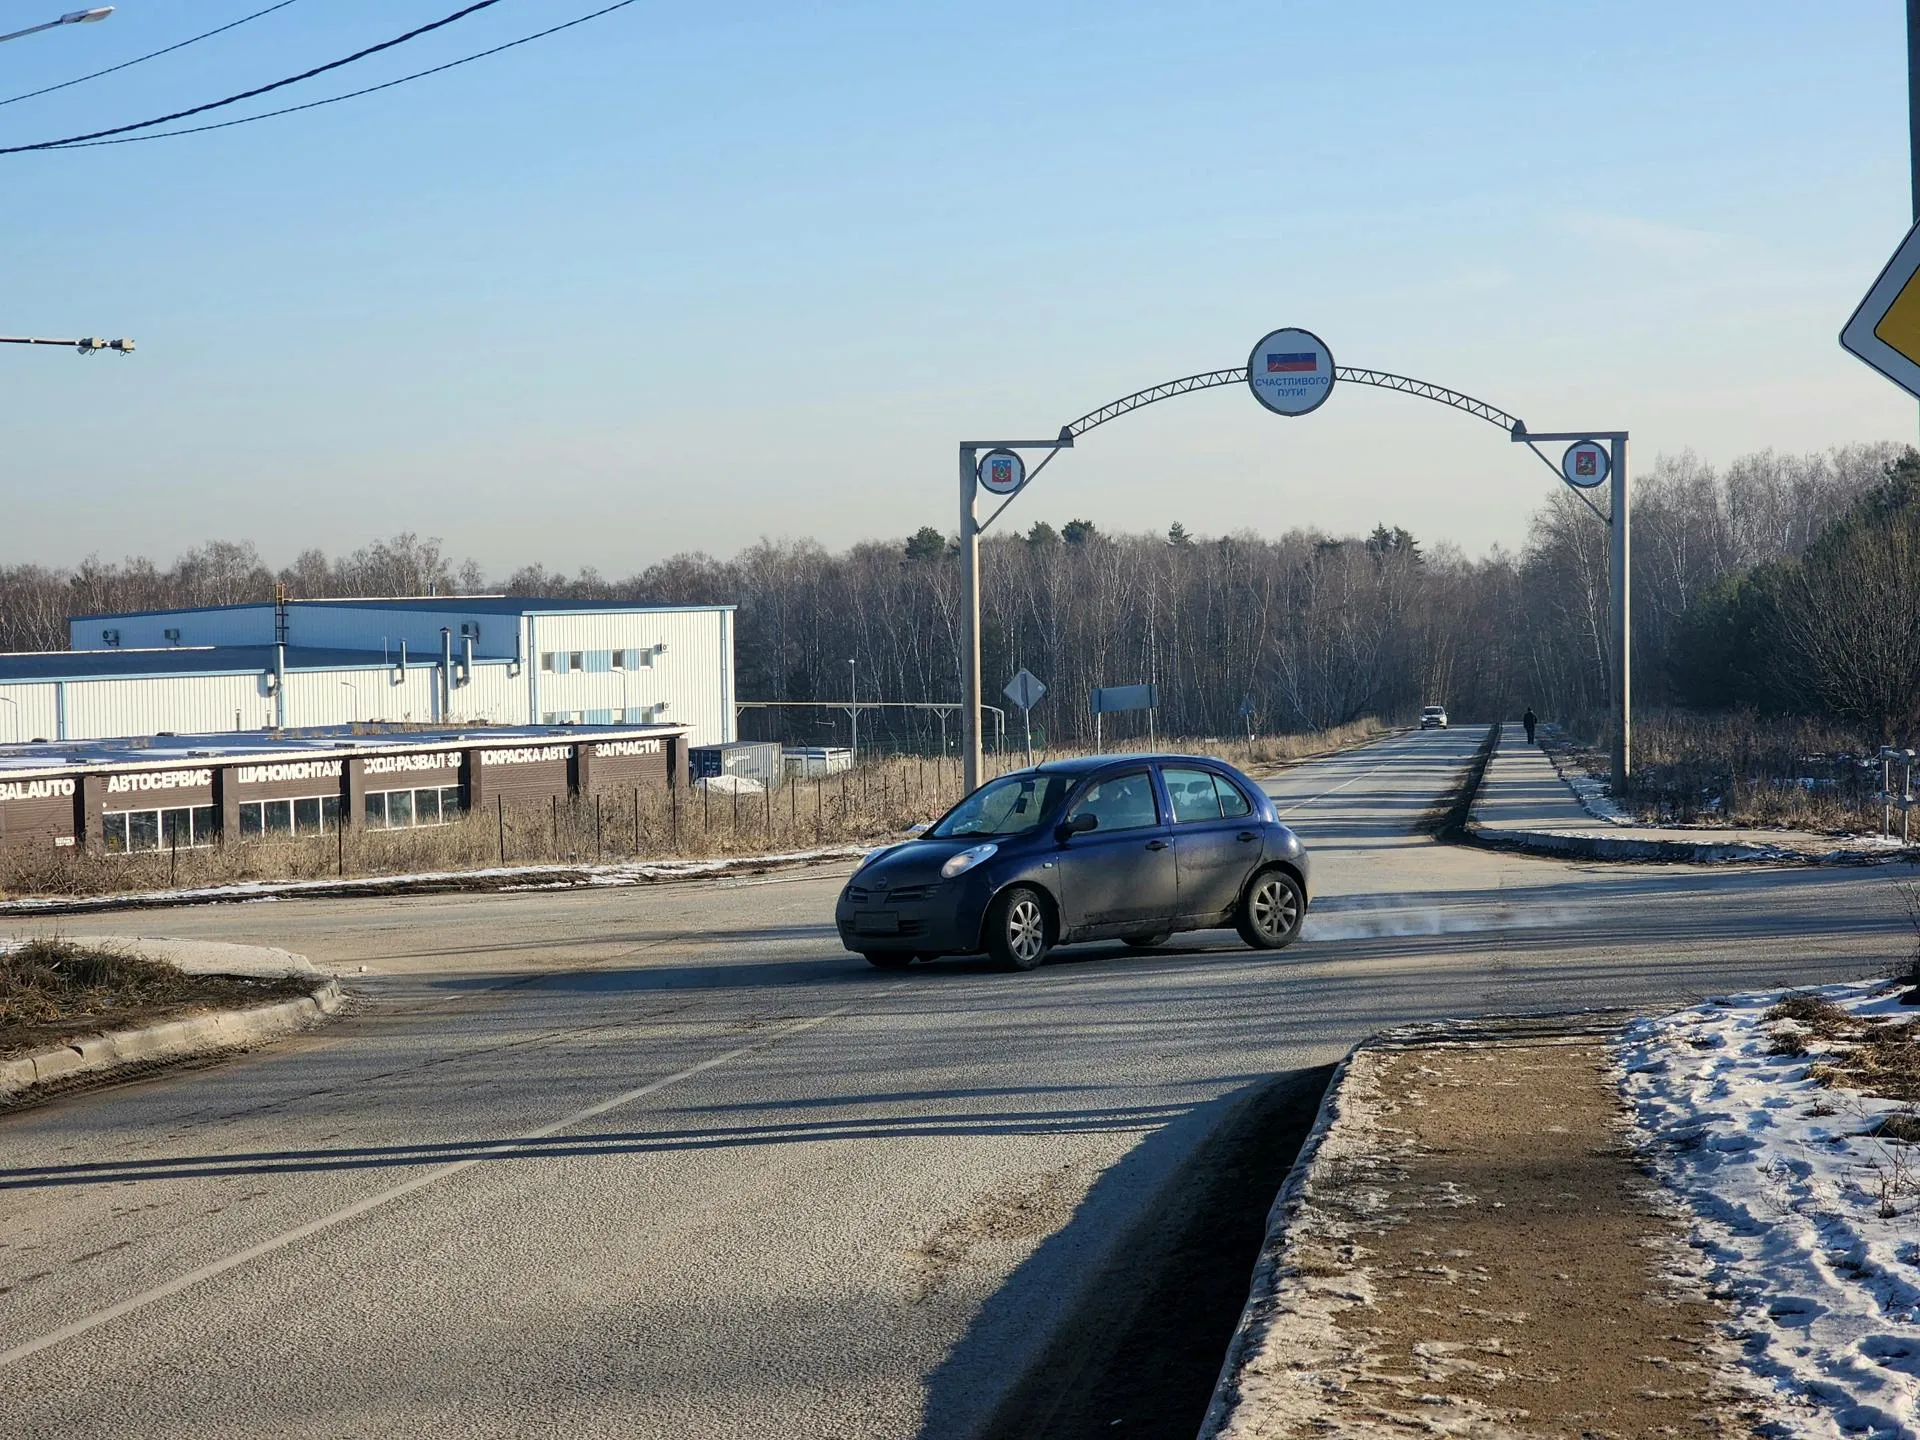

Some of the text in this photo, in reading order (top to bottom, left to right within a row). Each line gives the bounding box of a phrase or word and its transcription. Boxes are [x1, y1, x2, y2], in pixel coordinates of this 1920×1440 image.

[1255, 376, 1329, 387] СЧАСТЛИВОГО
[1277, 388, 1306, 397] ПУТИ!
[542, 745, 573, 761] АВТО
[595, 739, 660, 757] ЗАПЧАСТИ
[447, 752, 462, 768] 3D
[238, 760, 343, 783] ШИНОМОНТАЖ
[107, 769, 212, 793] АВТОСЕРВИС
